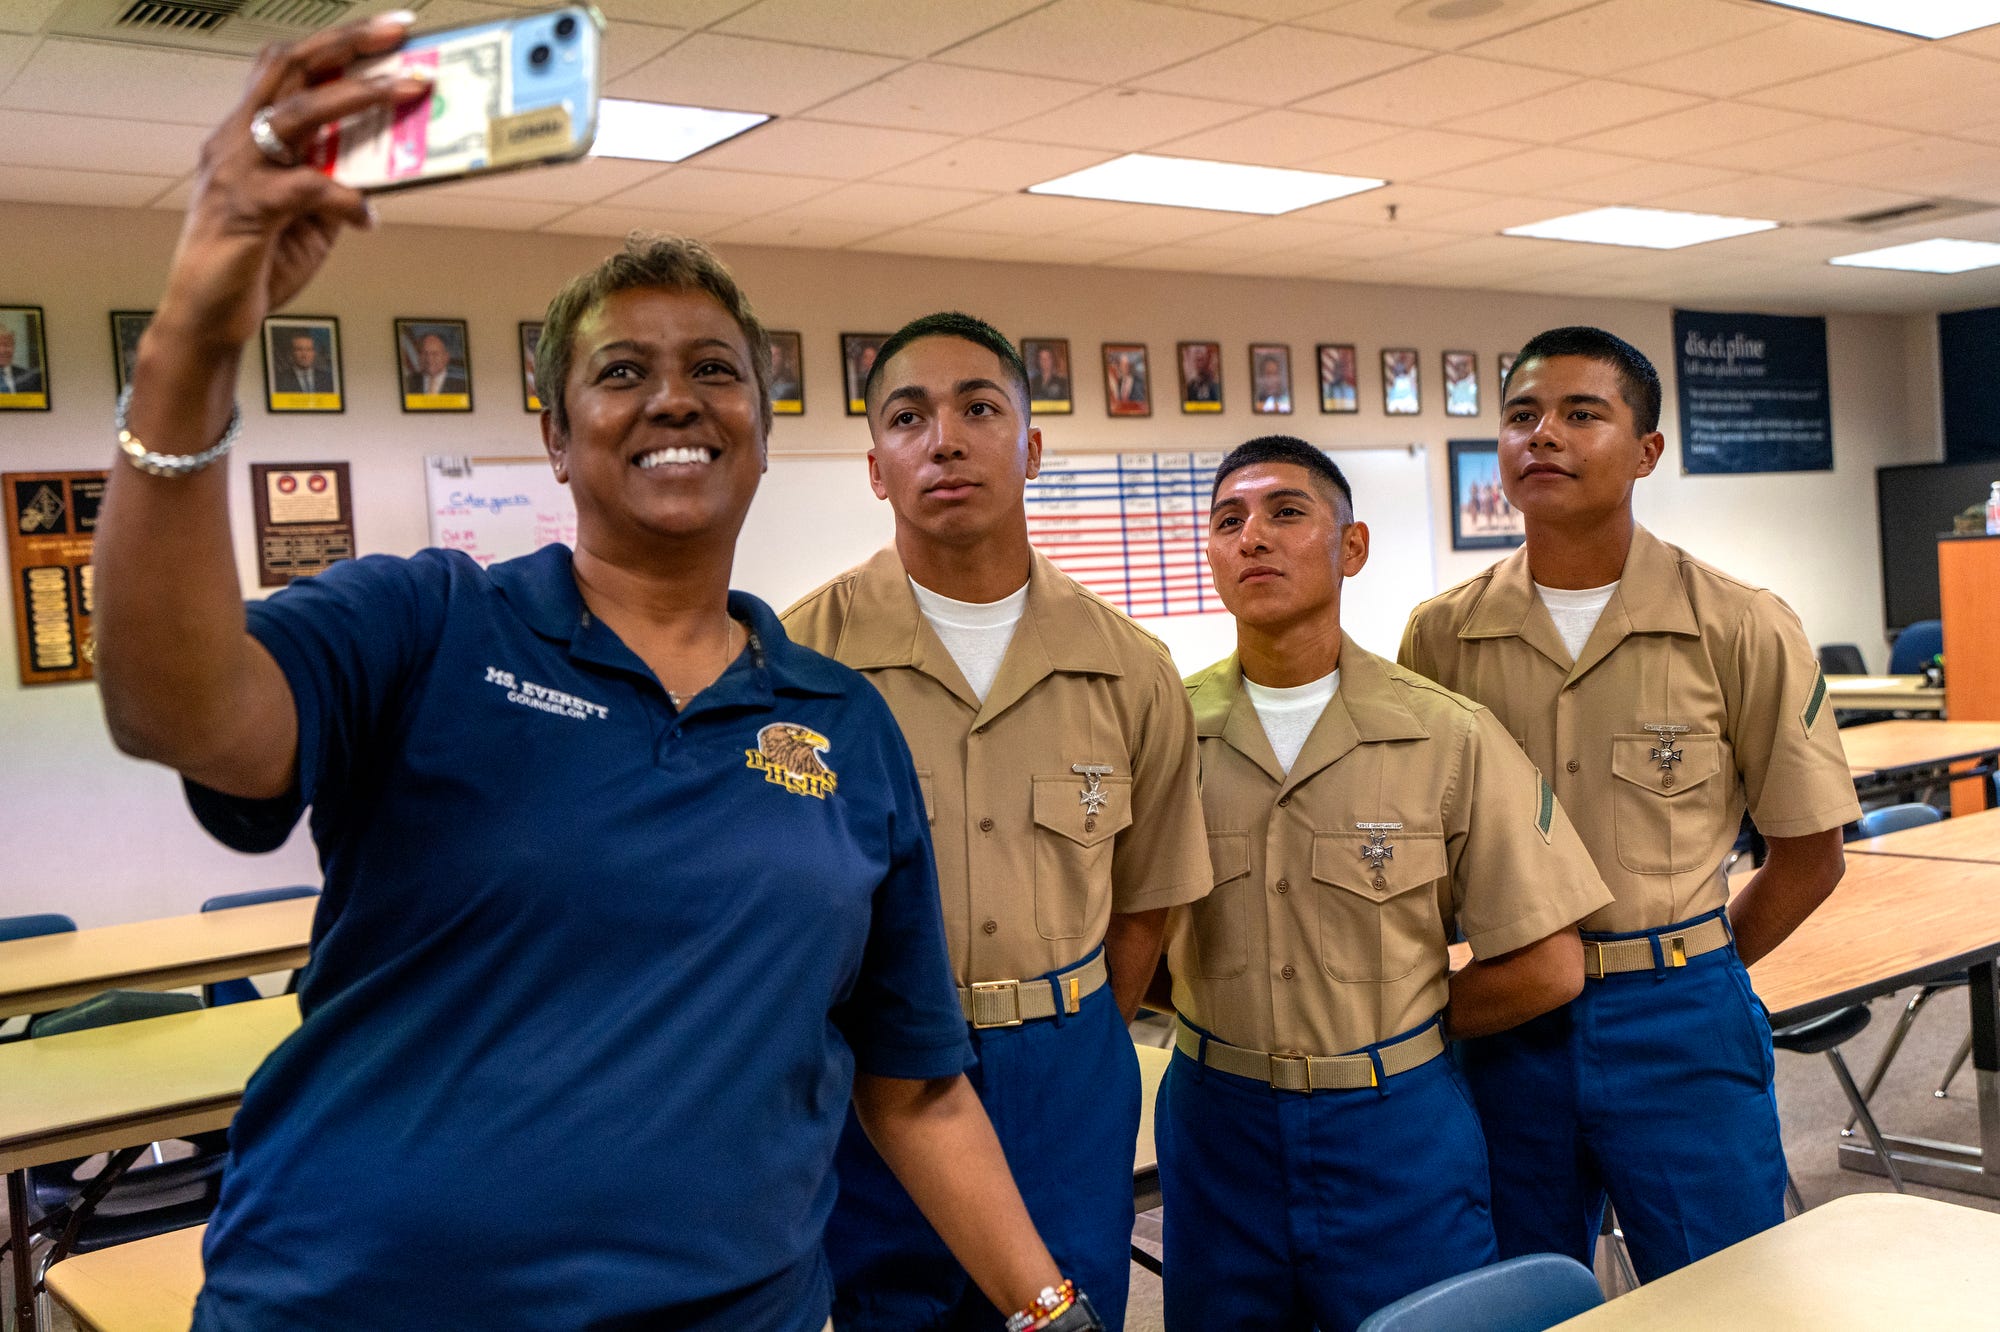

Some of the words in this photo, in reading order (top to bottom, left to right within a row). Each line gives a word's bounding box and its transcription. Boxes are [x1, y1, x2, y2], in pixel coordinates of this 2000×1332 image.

[484, 665, 518, 691] MS.
[521, 680, 609, 720] EVERETT
[506, 689, 588, 721] COUNSELOR
